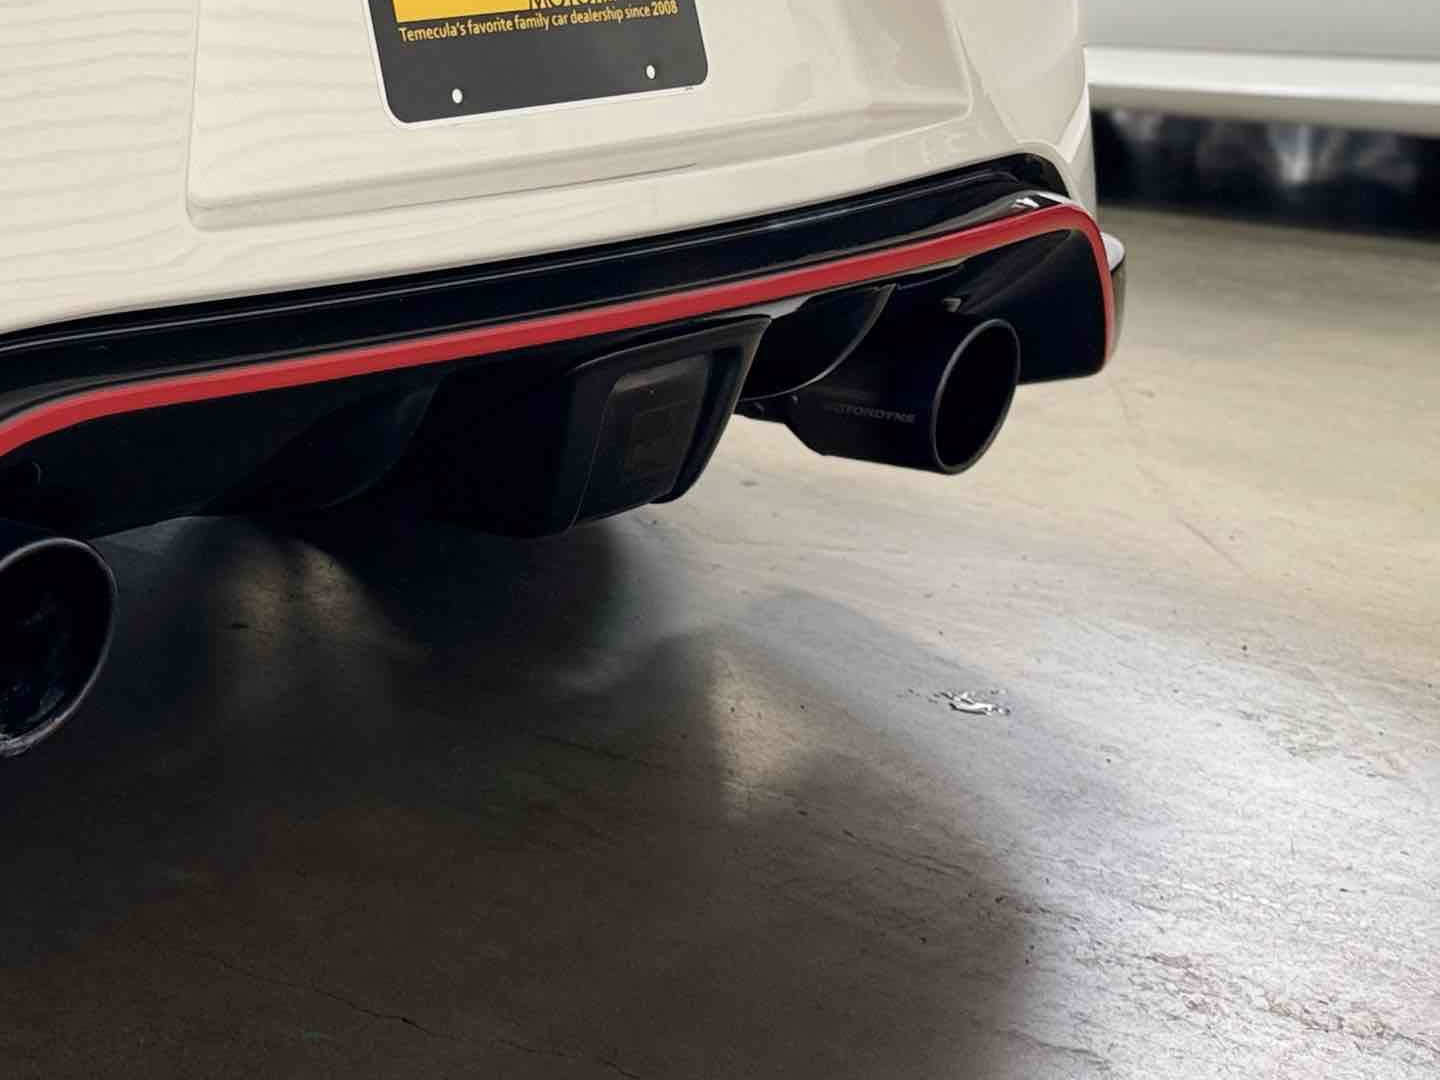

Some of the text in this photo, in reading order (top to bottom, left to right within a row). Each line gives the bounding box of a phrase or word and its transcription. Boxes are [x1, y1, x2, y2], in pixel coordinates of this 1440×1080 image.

[398, 0, 679, 43] Temecula's favorite family car dealership since 2008
